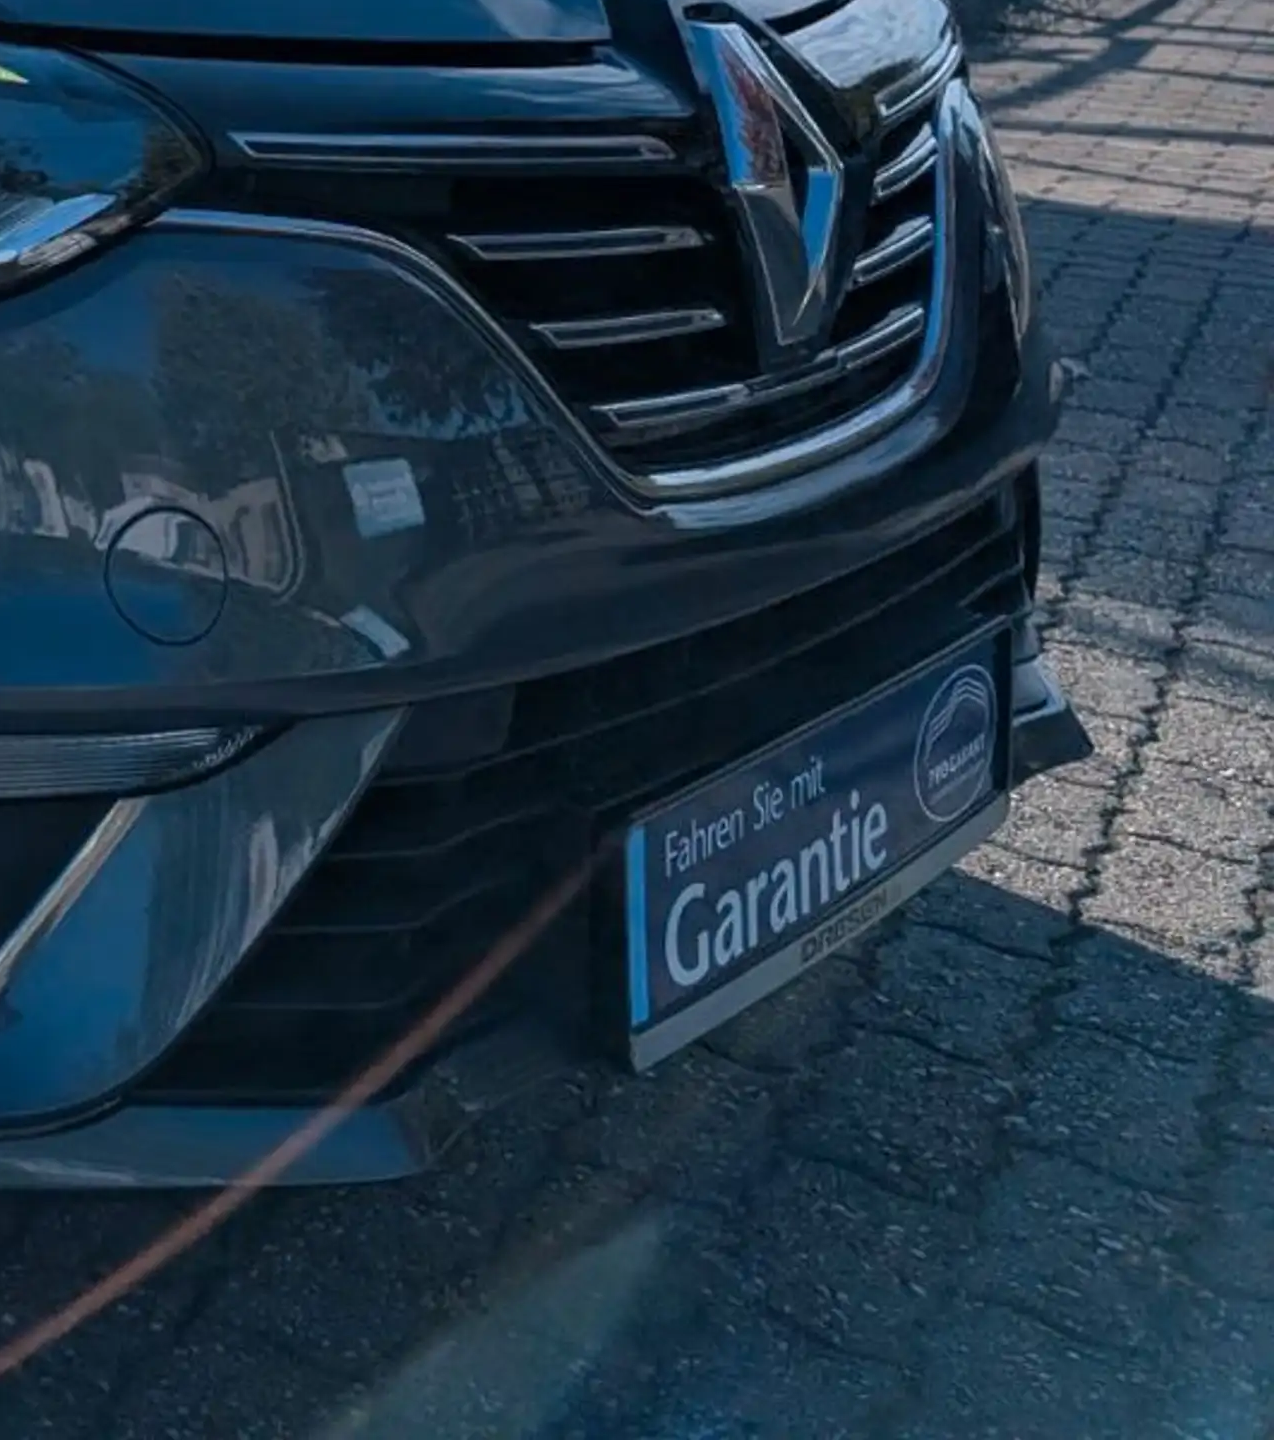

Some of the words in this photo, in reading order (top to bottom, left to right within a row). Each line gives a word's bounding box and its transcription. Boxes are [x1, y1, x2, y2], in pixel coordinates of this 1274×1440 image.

[664, 807, 744, 878] Fahren
[753, 780, 784, 831] Sie
[791, 755, 826, 810] mit
[664, 788, 889, 987] Garantie
